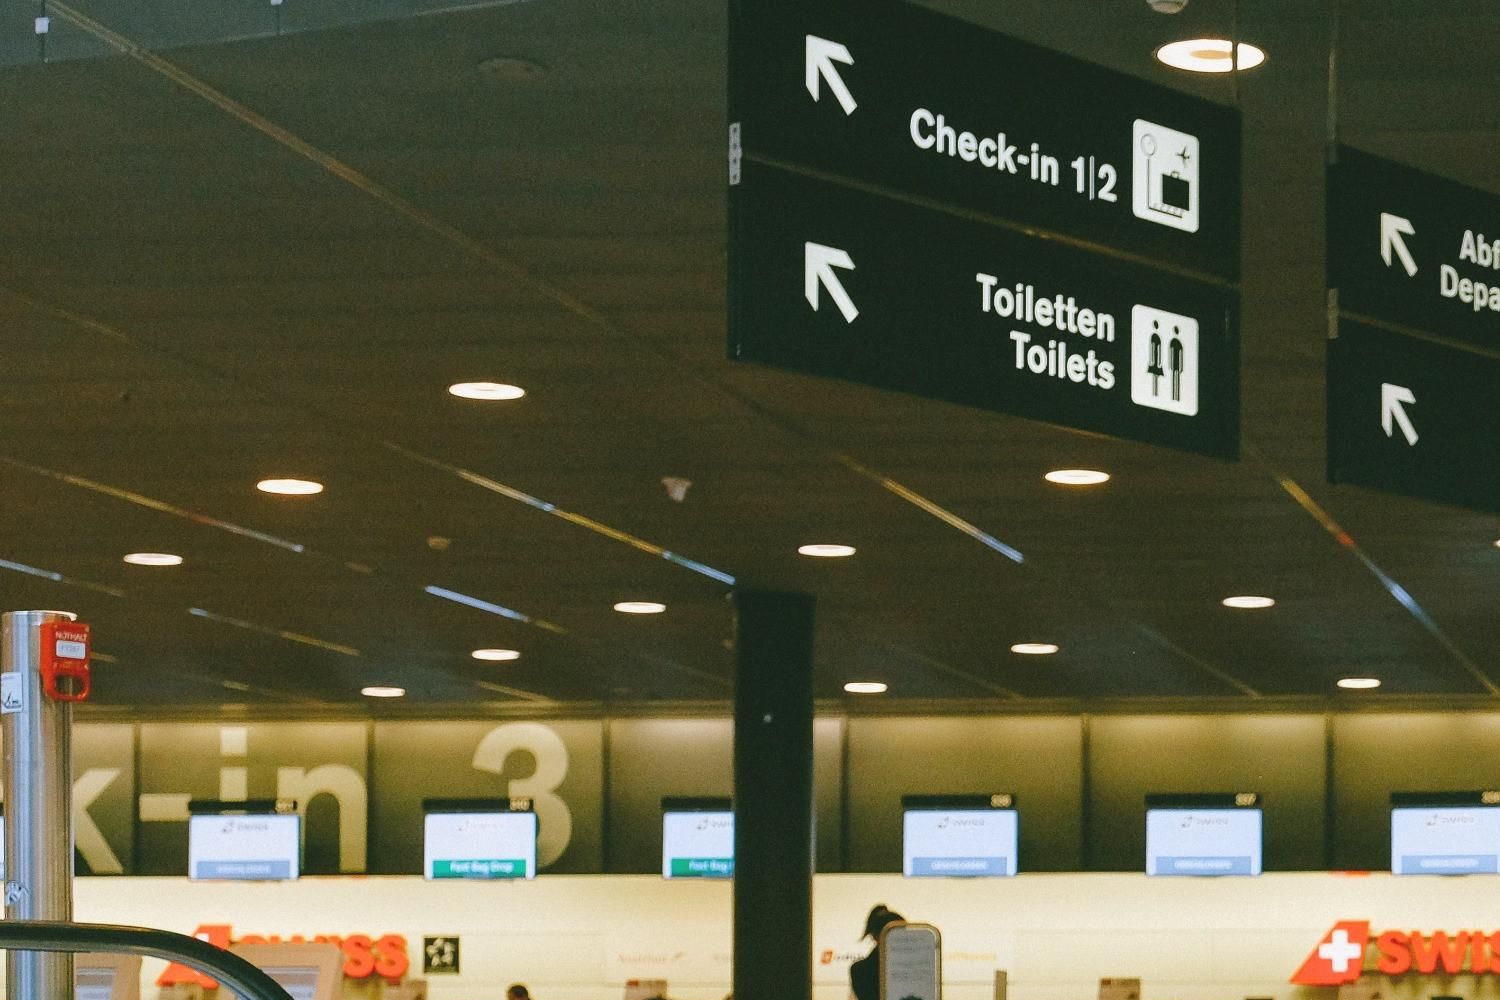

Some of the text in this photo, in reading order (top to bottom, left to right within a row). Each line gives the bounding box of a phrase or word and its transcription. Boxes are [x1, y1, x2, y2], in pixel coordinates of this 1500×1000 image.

[910, 108, 1059, 186] Check-in
[976, 273, 1115, 342] Toiletten
[1010, 330, 1115, 389] Toilets
[472, 722, 573, 869] 3
